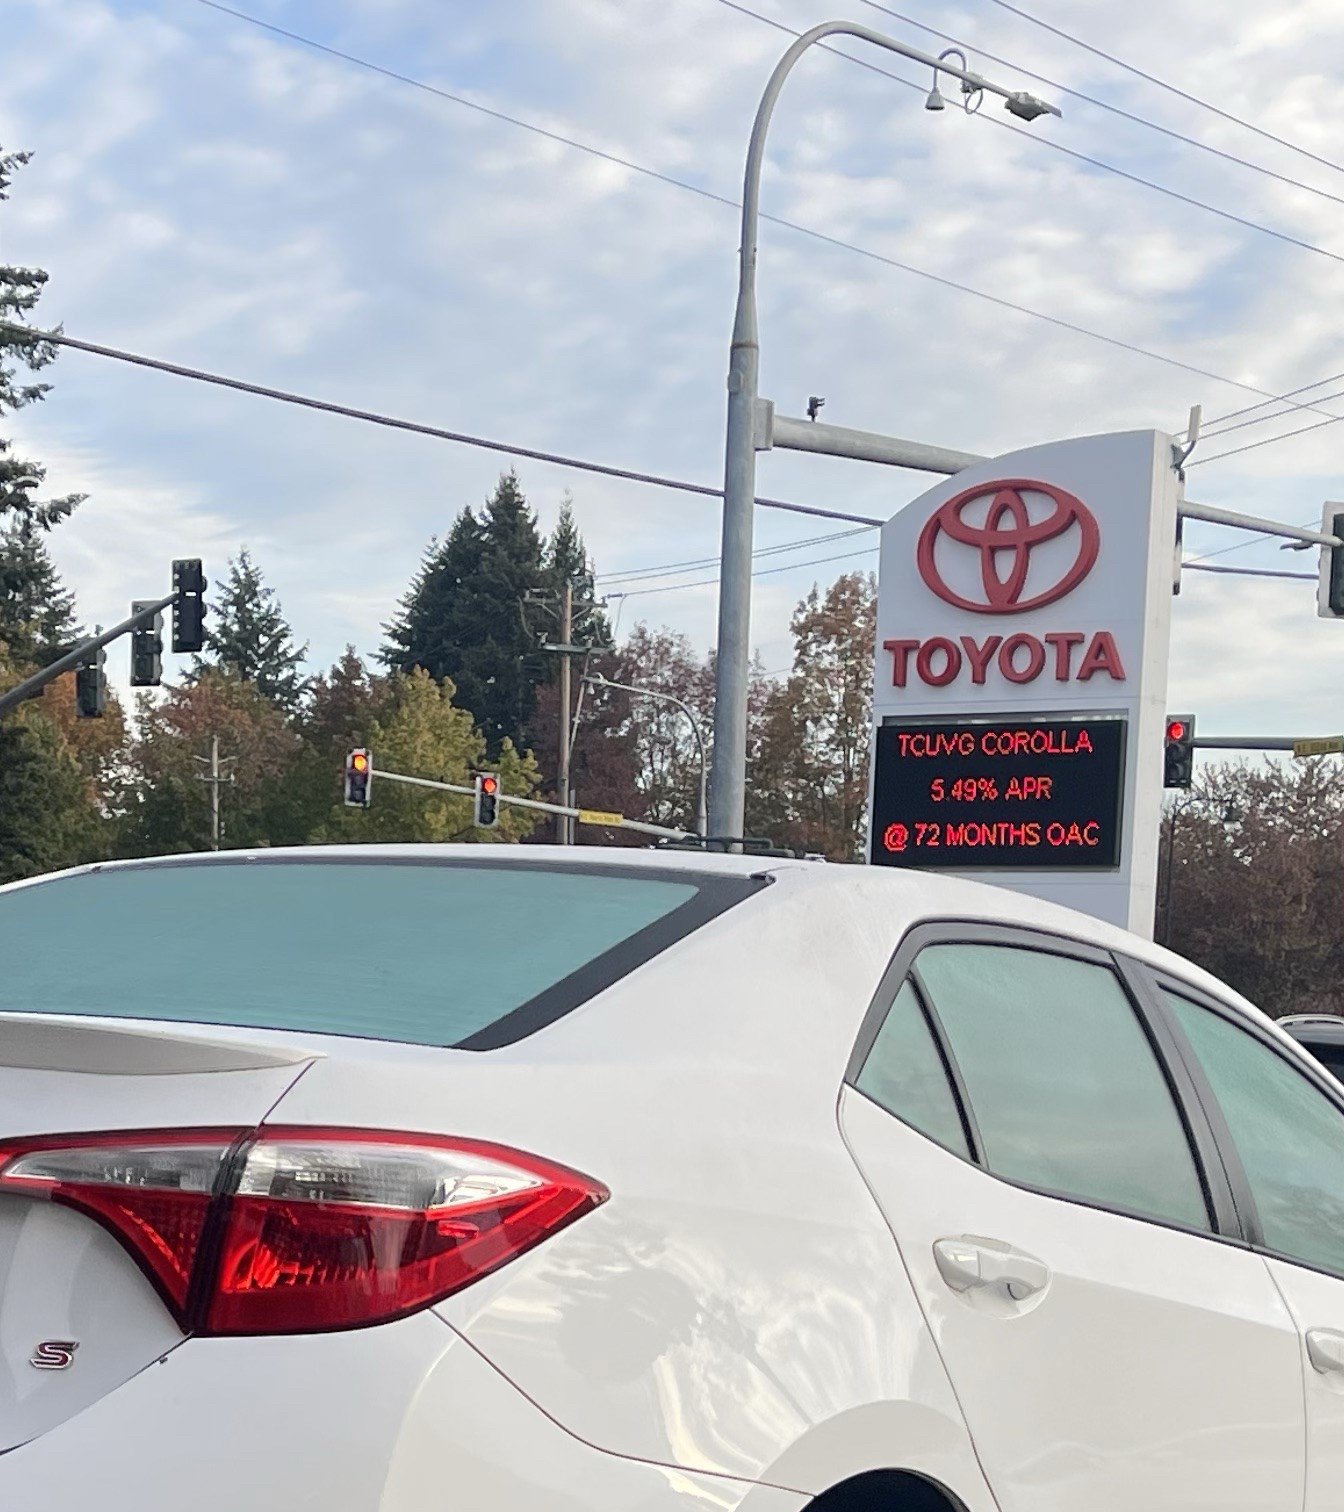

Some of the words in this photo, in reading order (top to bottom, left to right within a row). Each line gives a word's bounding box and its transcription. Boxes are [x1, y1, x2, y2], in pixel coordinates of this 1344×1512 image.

[883, 631, 1127, 687] TOYOTA
[898, 732, 975, 757] TCUVG
[981, 730, 1093, 756] COROLLA
[1004, 776, 1053, 801] APR
[883, 822, 909, 851] @
[914, 822, 940, 846] 72
[946, 822, 1041, 846] MONTHS
[1046, 821, 1101, 846] OAC
[29, 1340, 80, 1370] S
